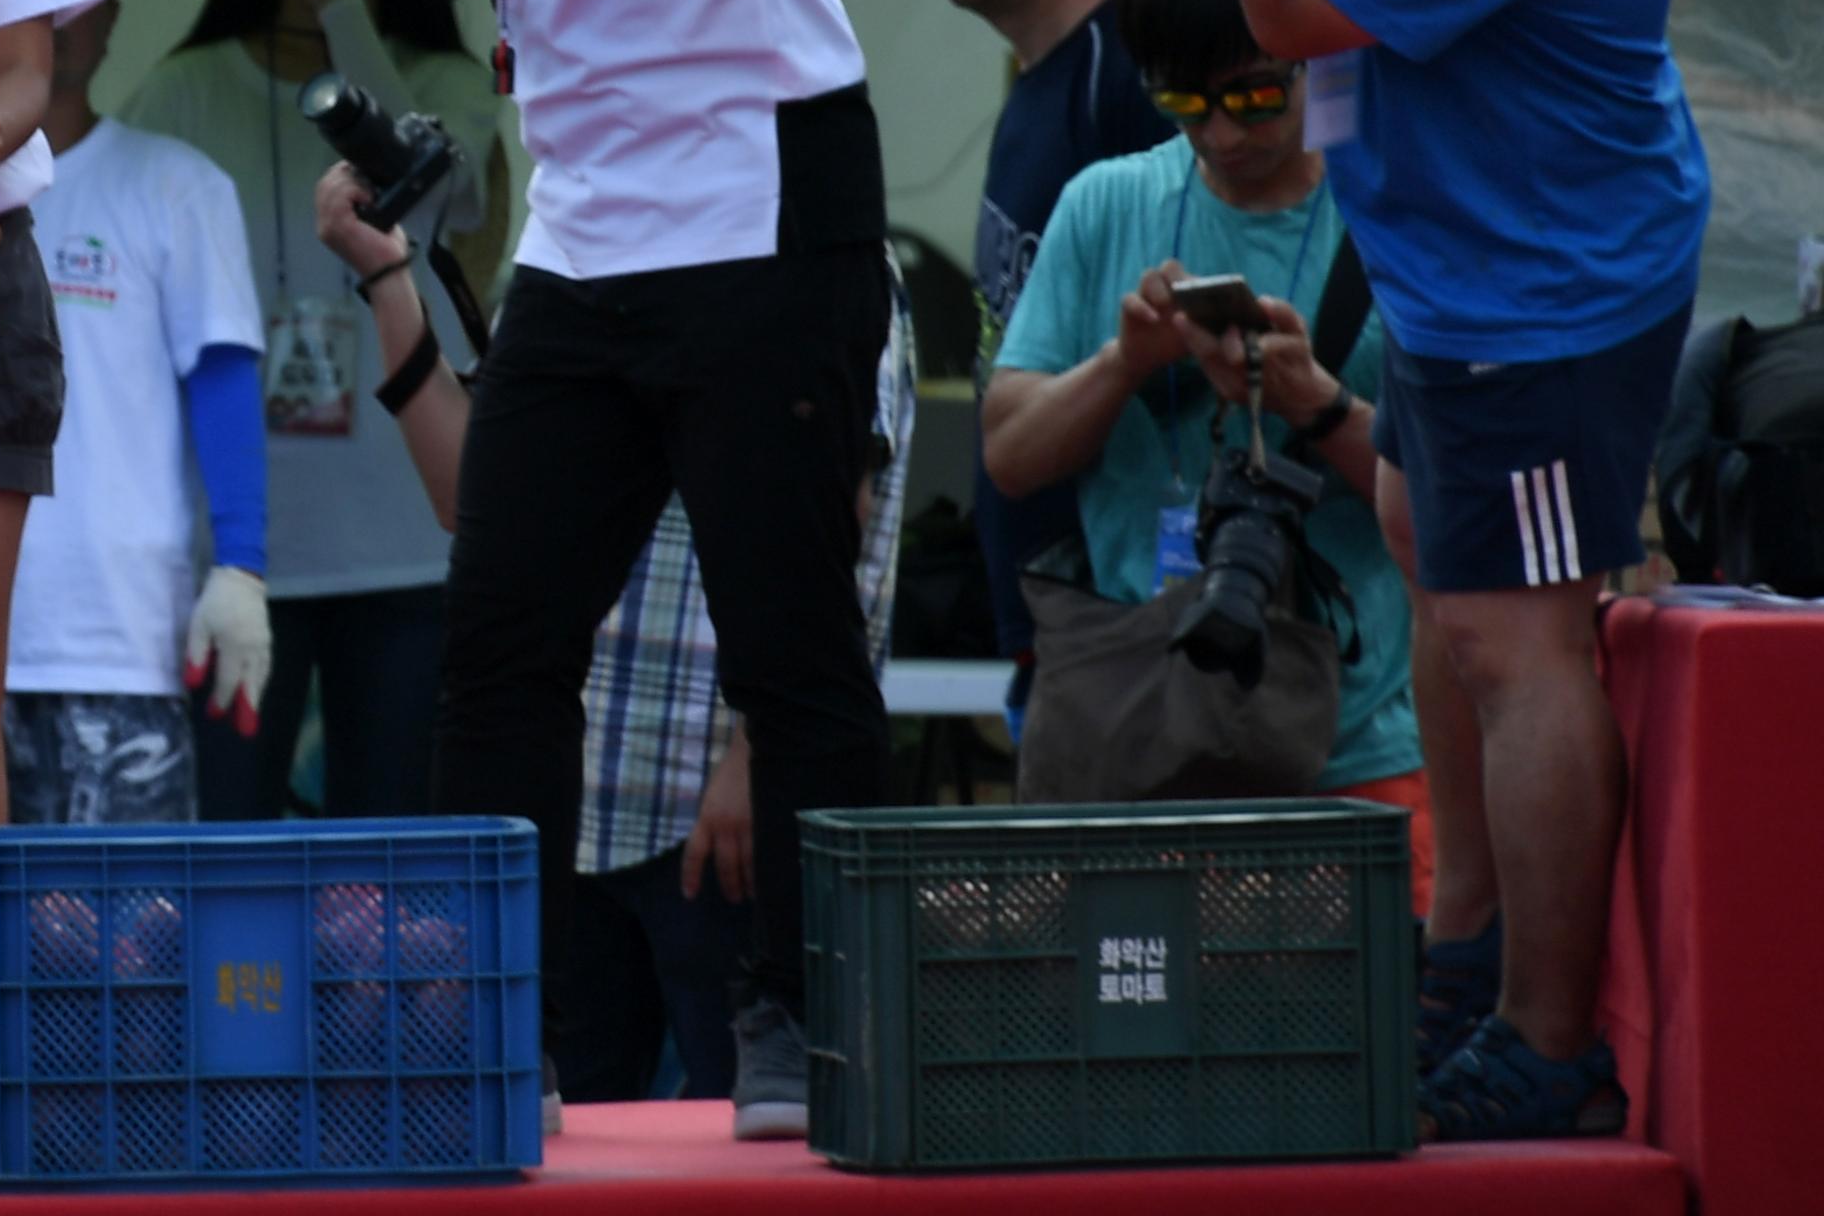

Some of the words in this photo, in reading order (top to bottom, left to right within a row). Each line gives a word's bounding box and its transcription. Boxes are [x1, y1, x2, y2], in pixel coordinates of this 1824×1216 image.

[1098, 936, 1166, 971] 화악산
[218, 959, 282, 1016] 화악산
[1098, 972, 1168, 1005] 토마토
